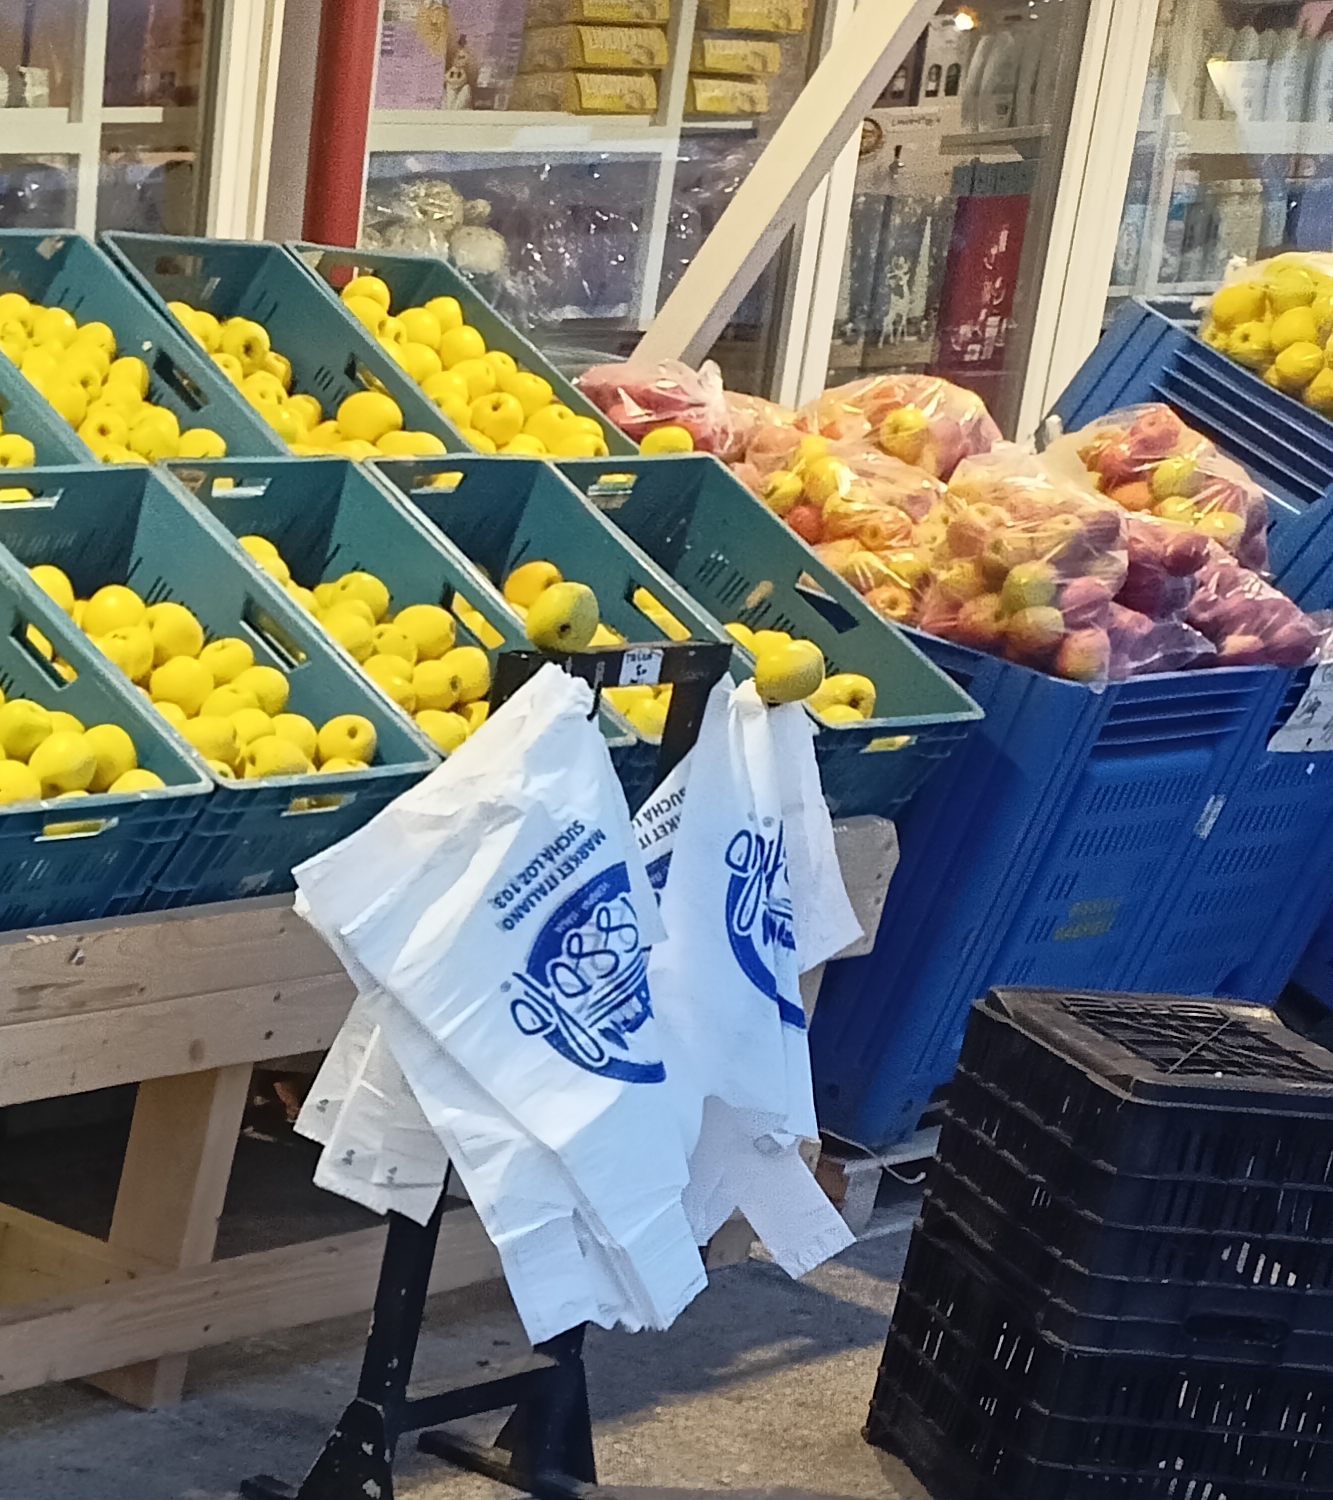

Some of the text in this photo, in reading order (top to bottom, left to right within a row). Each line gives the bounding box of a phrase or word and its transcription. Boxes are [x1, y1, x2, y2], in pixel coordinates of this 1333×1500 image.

[556, 828, 606, 880] MARKET
[492, 881, 521, 908] 103
[500, 873, 559, 932] ITALIANO
